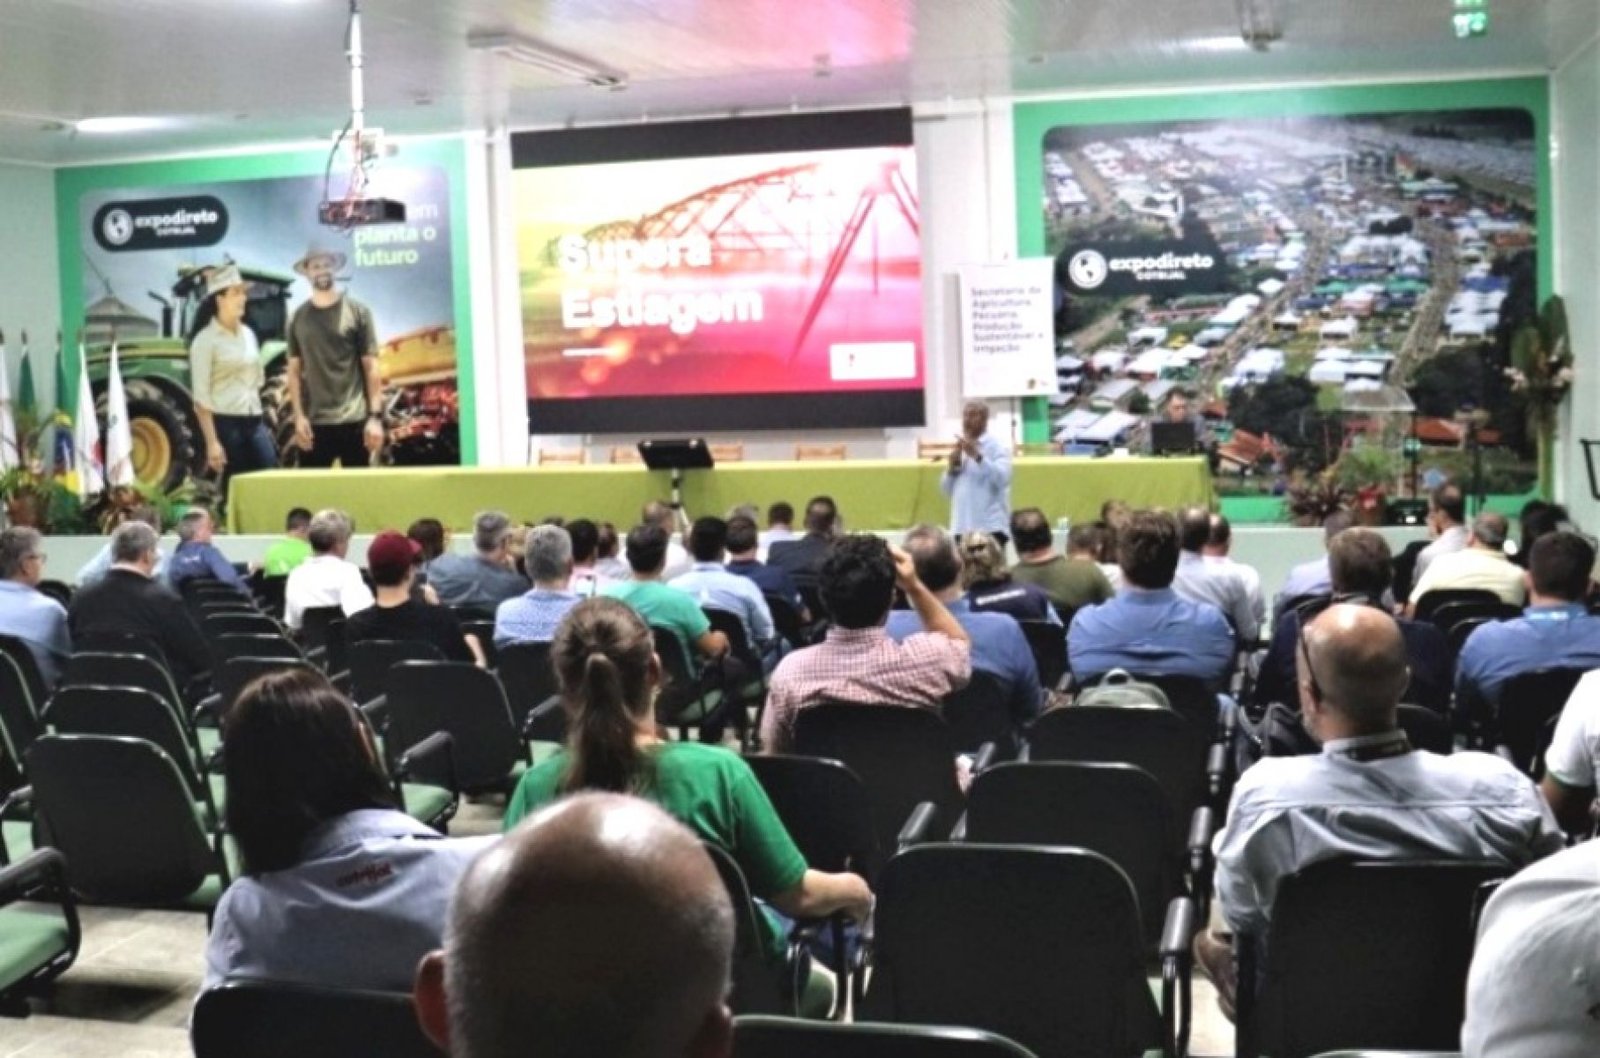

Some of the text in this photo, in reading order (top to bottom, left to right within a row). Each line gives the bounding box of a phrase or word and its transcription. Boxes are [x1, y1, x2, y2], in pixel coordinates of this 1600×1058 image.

[134, 209, 218, 229] expodireto
[354, 225, 437, 248] planta o
[355, 248, 419, 267] futuro
[558, 231, 712, 278] Supera
[1109, 252, 1214, 273] expodireto
[561, 287, 764, 335] Estiagem
